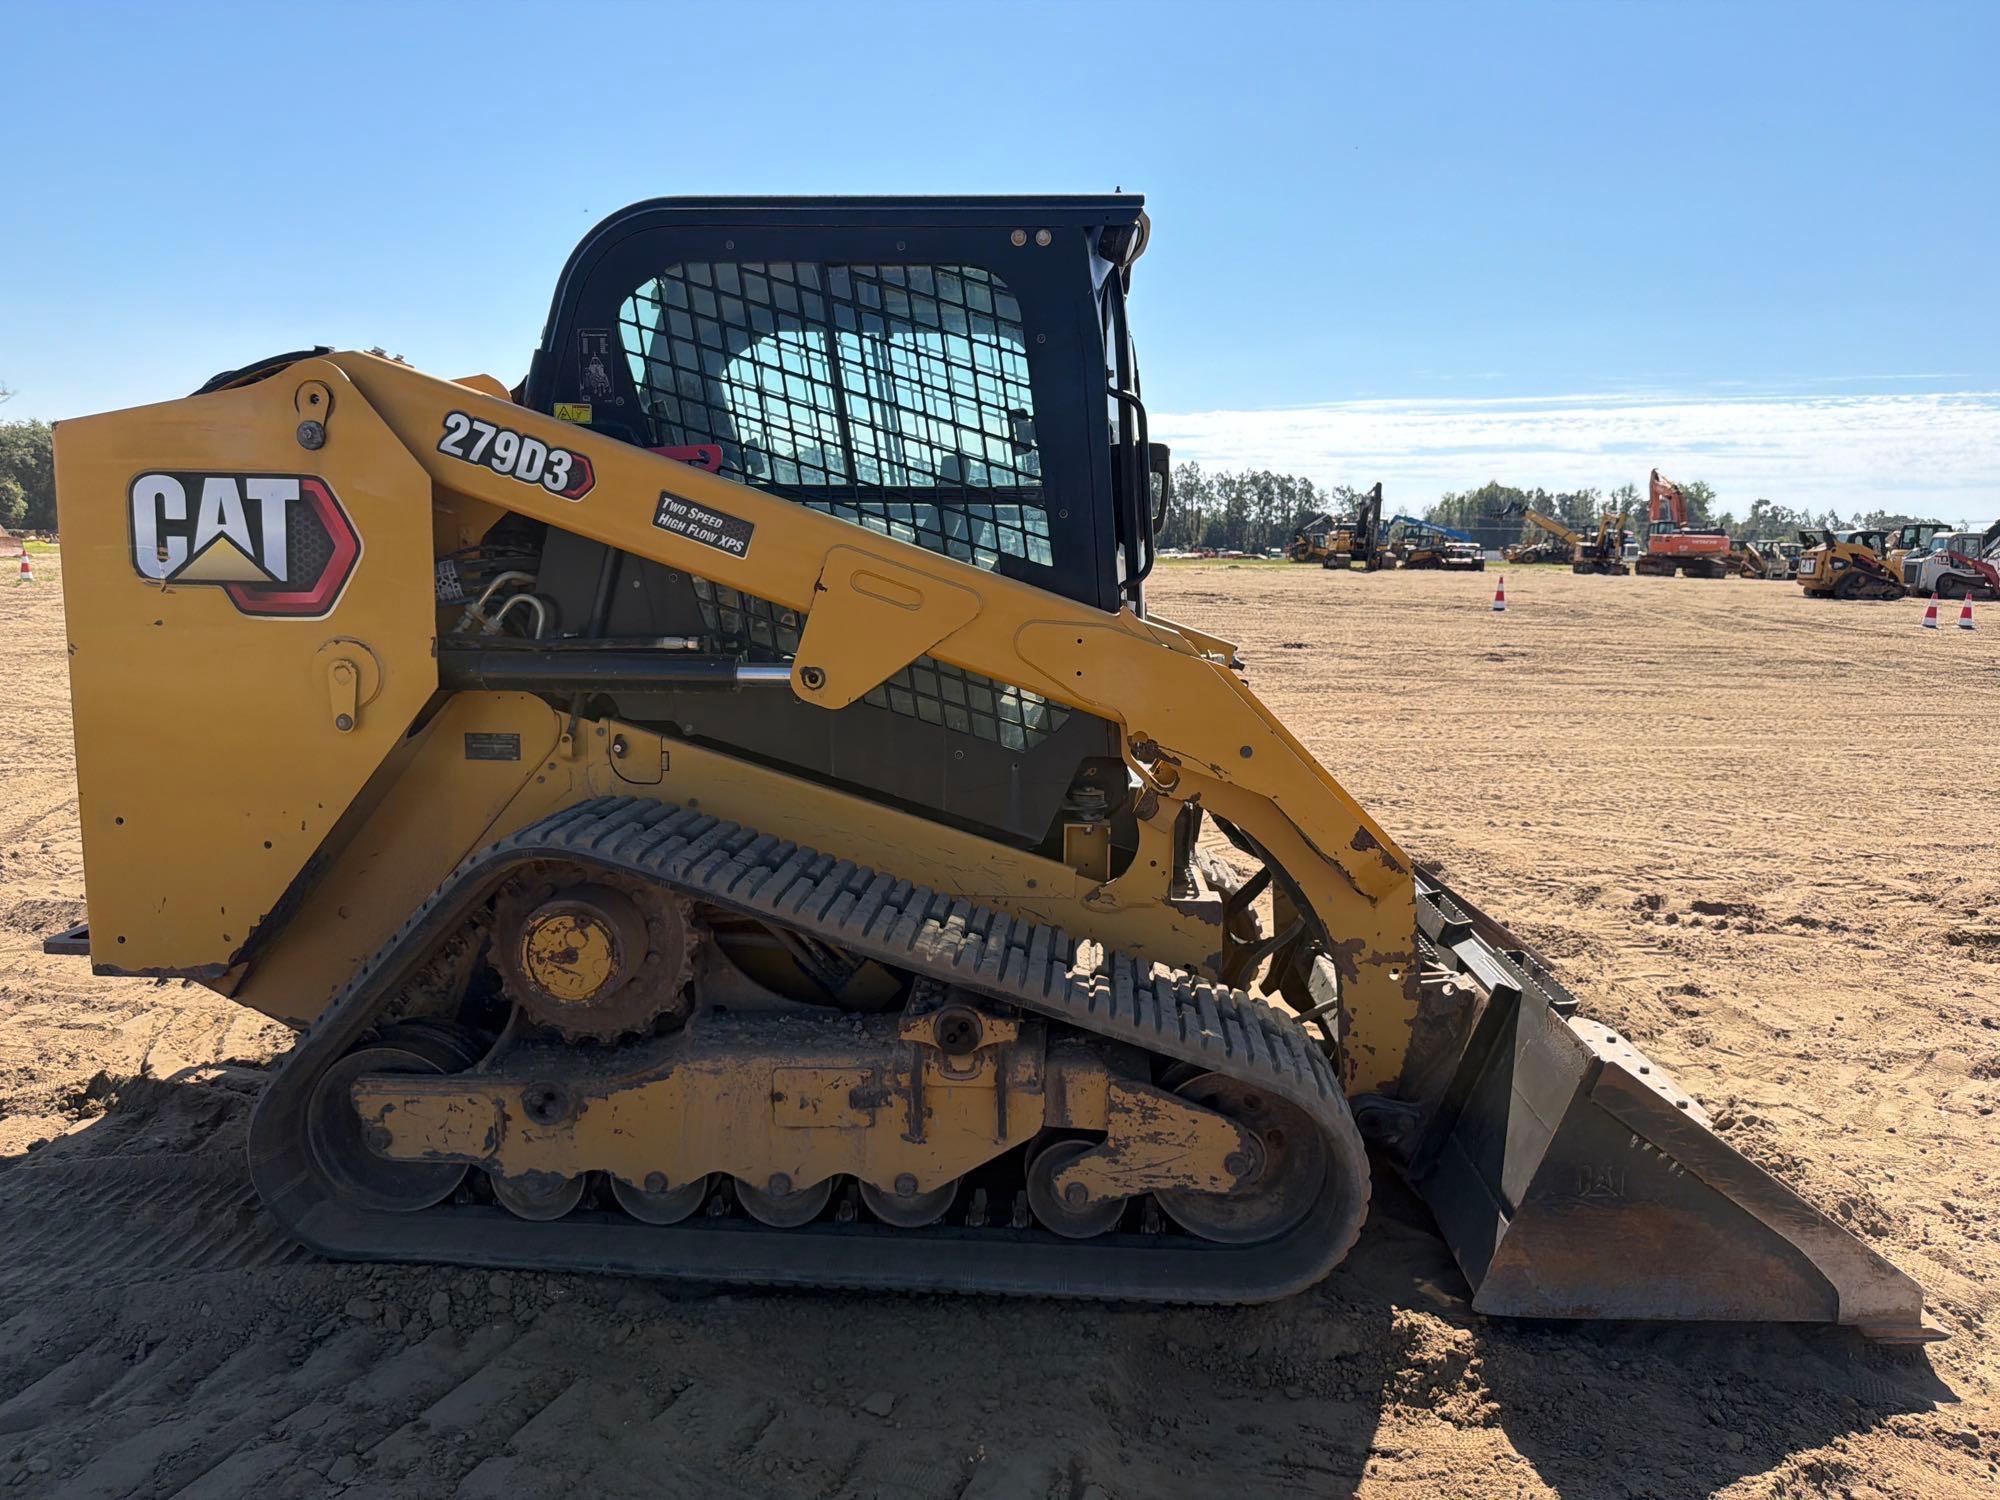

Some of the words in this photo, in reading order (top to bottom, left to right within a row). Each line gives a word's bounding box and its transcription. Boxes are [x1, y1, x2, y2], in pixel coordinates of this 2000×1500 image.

[439, 413, 573, 492] 279D3
[132, 474, 300, 582] CAT
[717, 534, 745, 553] XPS
[1800, 559, 1815, 574] CAT
